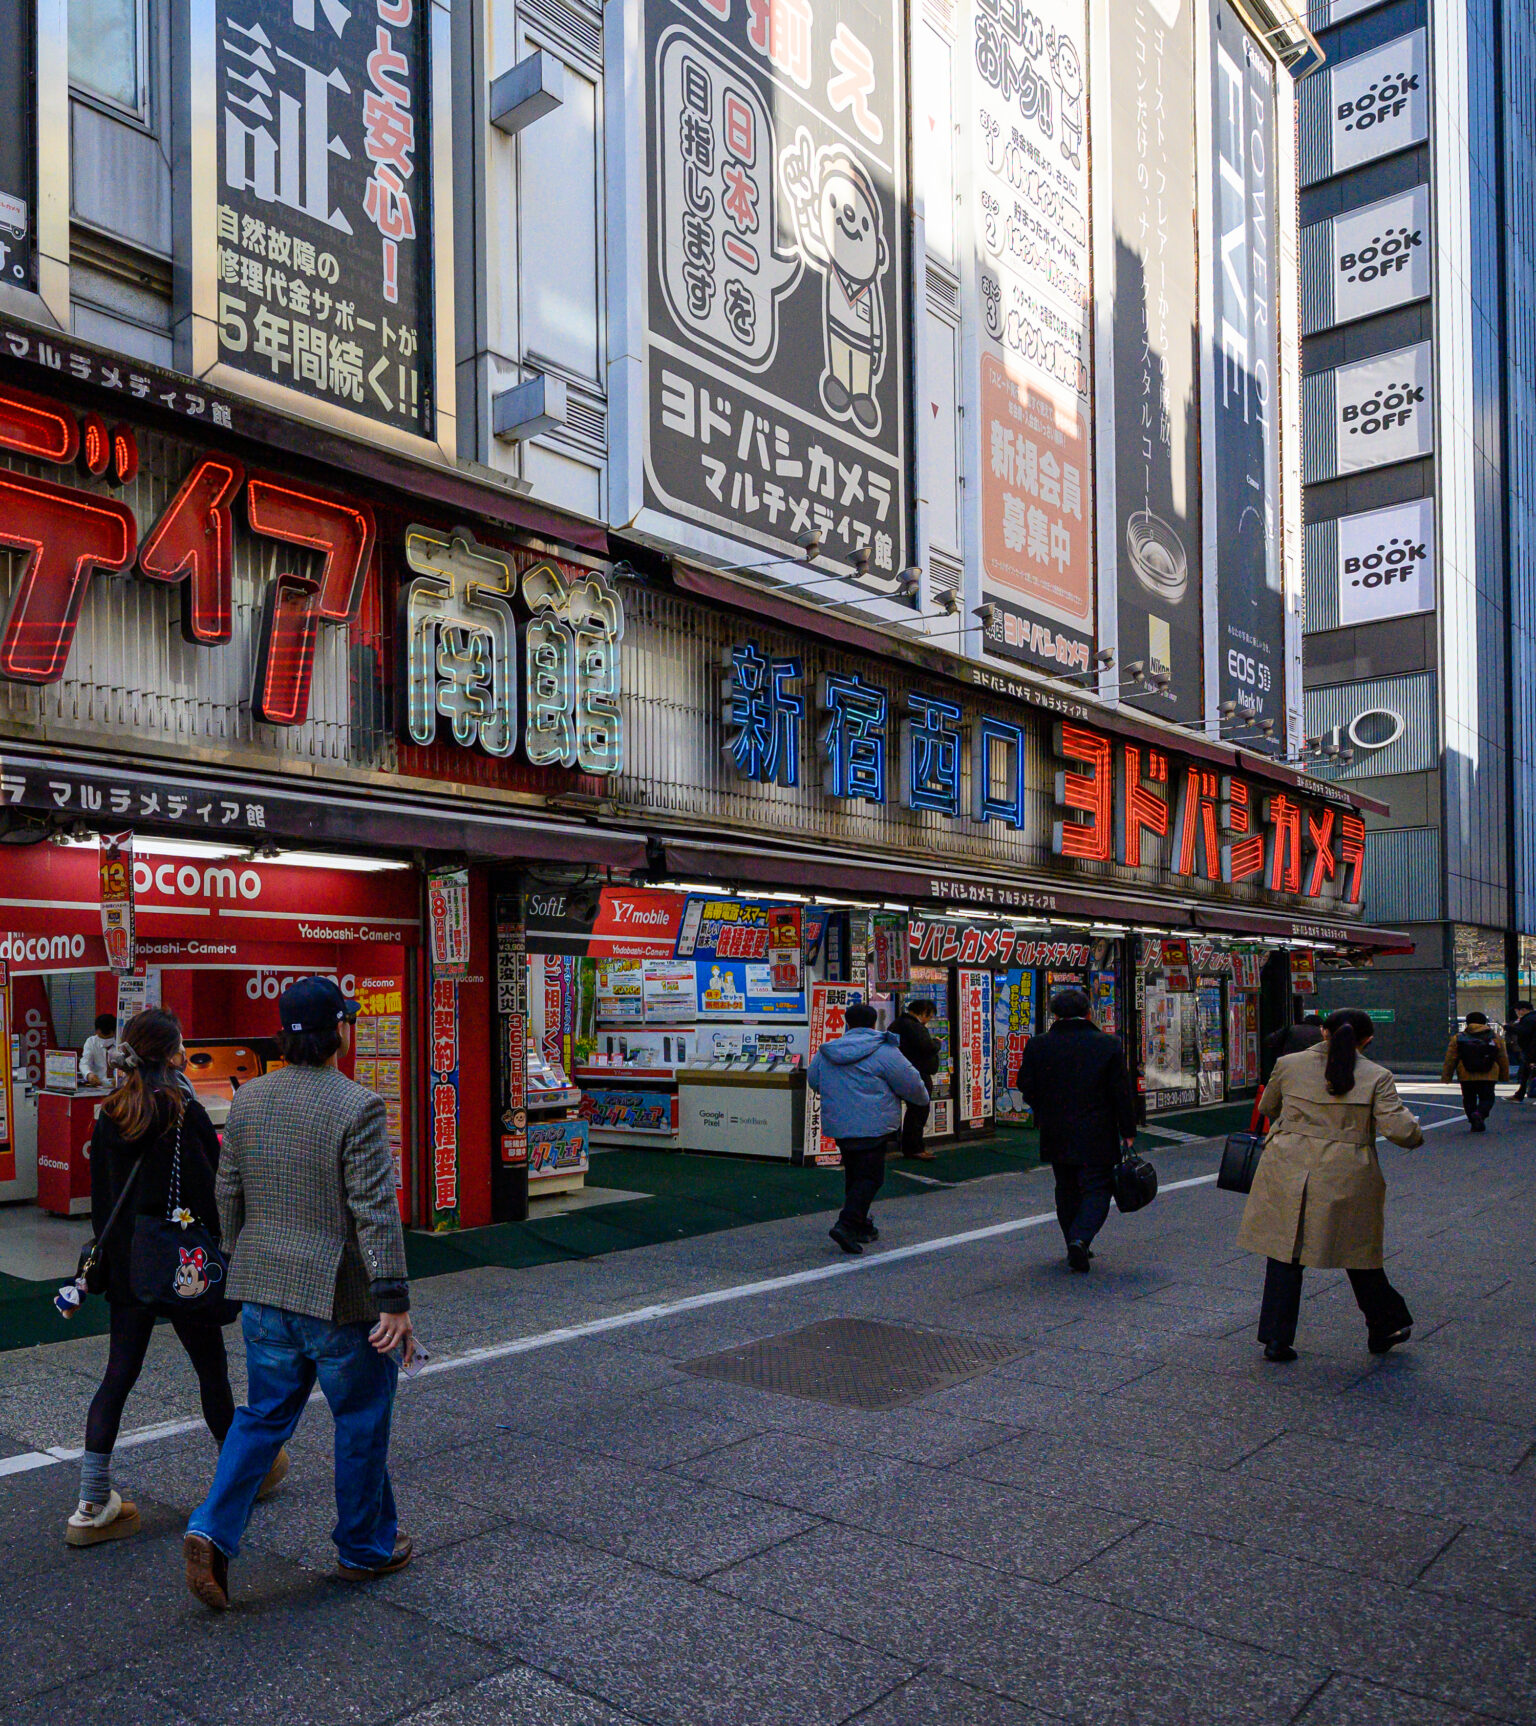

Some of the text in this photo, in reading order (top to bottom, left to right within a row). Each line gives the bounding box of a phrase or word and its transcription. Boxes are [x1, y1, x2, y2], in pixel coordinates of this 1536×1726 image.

[1242, 35, 1270, 86] Canon
[1337, 68, 1420, 121] BOOK
[1357, 97, 1408, 131] OFF
[1250, 85, 1268, 328] POWER
[217, 204, 340, 285] 自然故障の
[1340, 226, 1423, 273] BOOK
[1358, 251, 1411, 284] OFF
[217, 243, 418, 357] 修理代金サポートが
[217, 292, 418, 419] 5年間続く!!
[4, 331, 233, 428] マルチメディア館
[1342, 384, 1426, 424] BOOK
[1360, 408, 1413, 436] OFF
[661, 369, 892, 522] ヨドバシカメラ
[990, 418, 1083, 523] 新規会員
[700, 454, 894, 571] マルチメディア館
[1001, 491, 1071, 575] 募集中
[1345, 540, 1427, 574] BOOK
[1362, 564, 1415, 588] OFF
[405, 522, 626, 778] 南館
[1004, 612, 1090, 672] ヨドバシカメラ
[972, 669, 1032, 702] ヨドバシカメラ
[1228, 648, 1271, 691] EOS 5D
[1238, 687, 1255, 710] Mark
[722, 638, 1367, 905] 新宿西口 ヨドバシカメラ
[49, 780, 267, 829] マルチメディア館
[133, 863, 262, 900] ocomo
[930, 880, 994, 903] ヨドバシカメラ
[0, 932, 86, 962] docomo
[298, 923, 402, 942] Yodobashi-Camera
[612, 943, 670, 957] Yodobashi-Camera
[716, 923, 769, 959] 機種変更
[362, 977, 395, 988] docomo
[498, 954, 515, 981] 水没
[1136, 976, 1145, 993] 水没
[498, 984, 515, 1014] 火災
[826, 989, 847, 1005] 最短
[433, 979, 457, 1211] 規契約・機種変更
[699, 1109, 724, 1119] Google
[703, 1118, 720, 1127] Pixel
[38, 1155, 70, 1171] docomo
